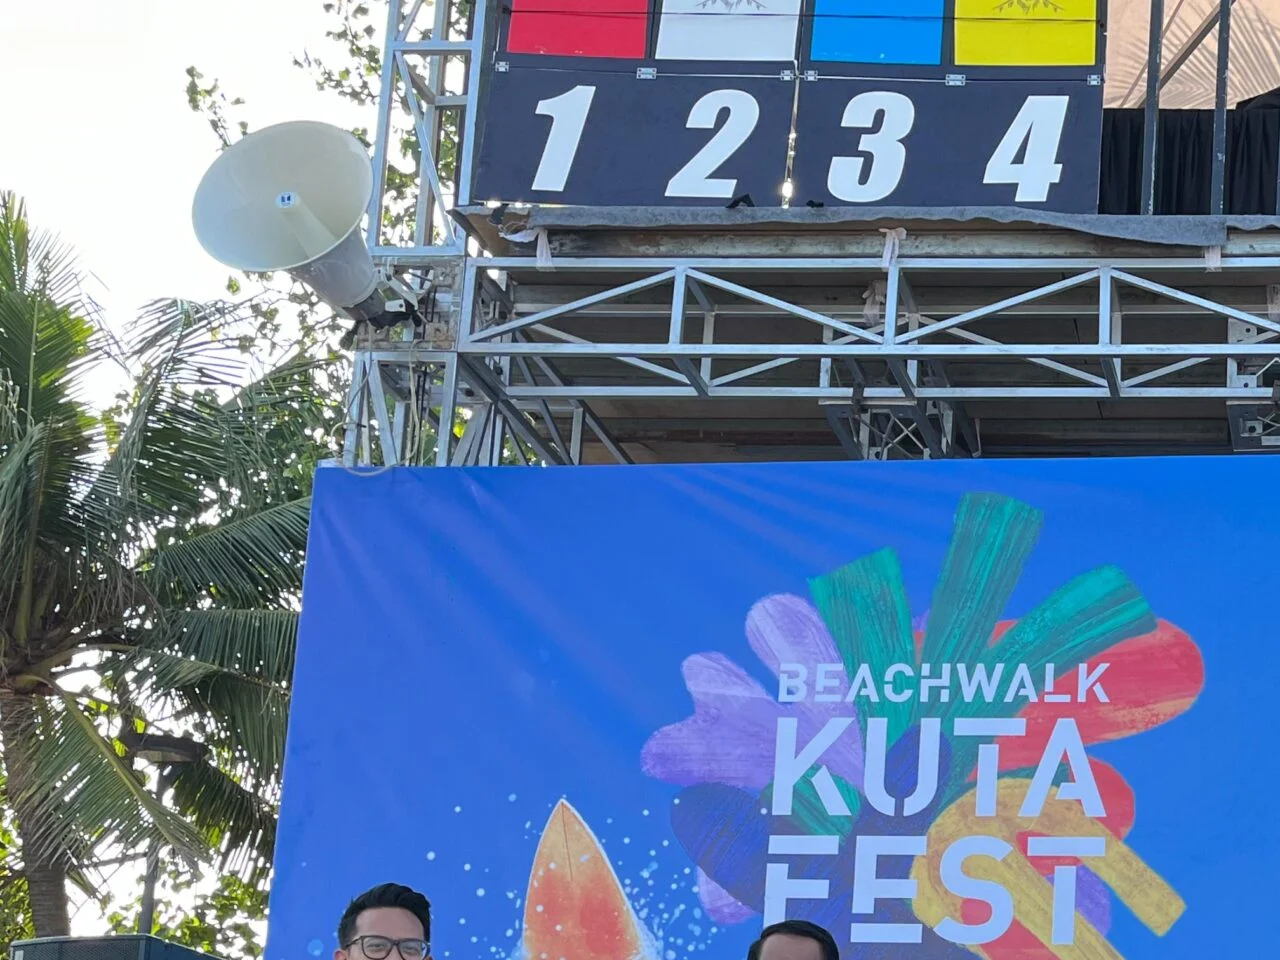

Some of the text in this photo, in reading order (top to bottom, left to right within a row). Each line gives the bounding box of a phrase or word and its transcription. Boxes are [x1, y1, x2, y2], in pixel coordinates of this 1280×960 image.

[532, 85, 1070, 203] 1 2 3 4
[778, 663, 1111, 703] BEACHWALK
[771, 717, 1107, 818] KUTA
[763, 835, 1106, 945] FEST
